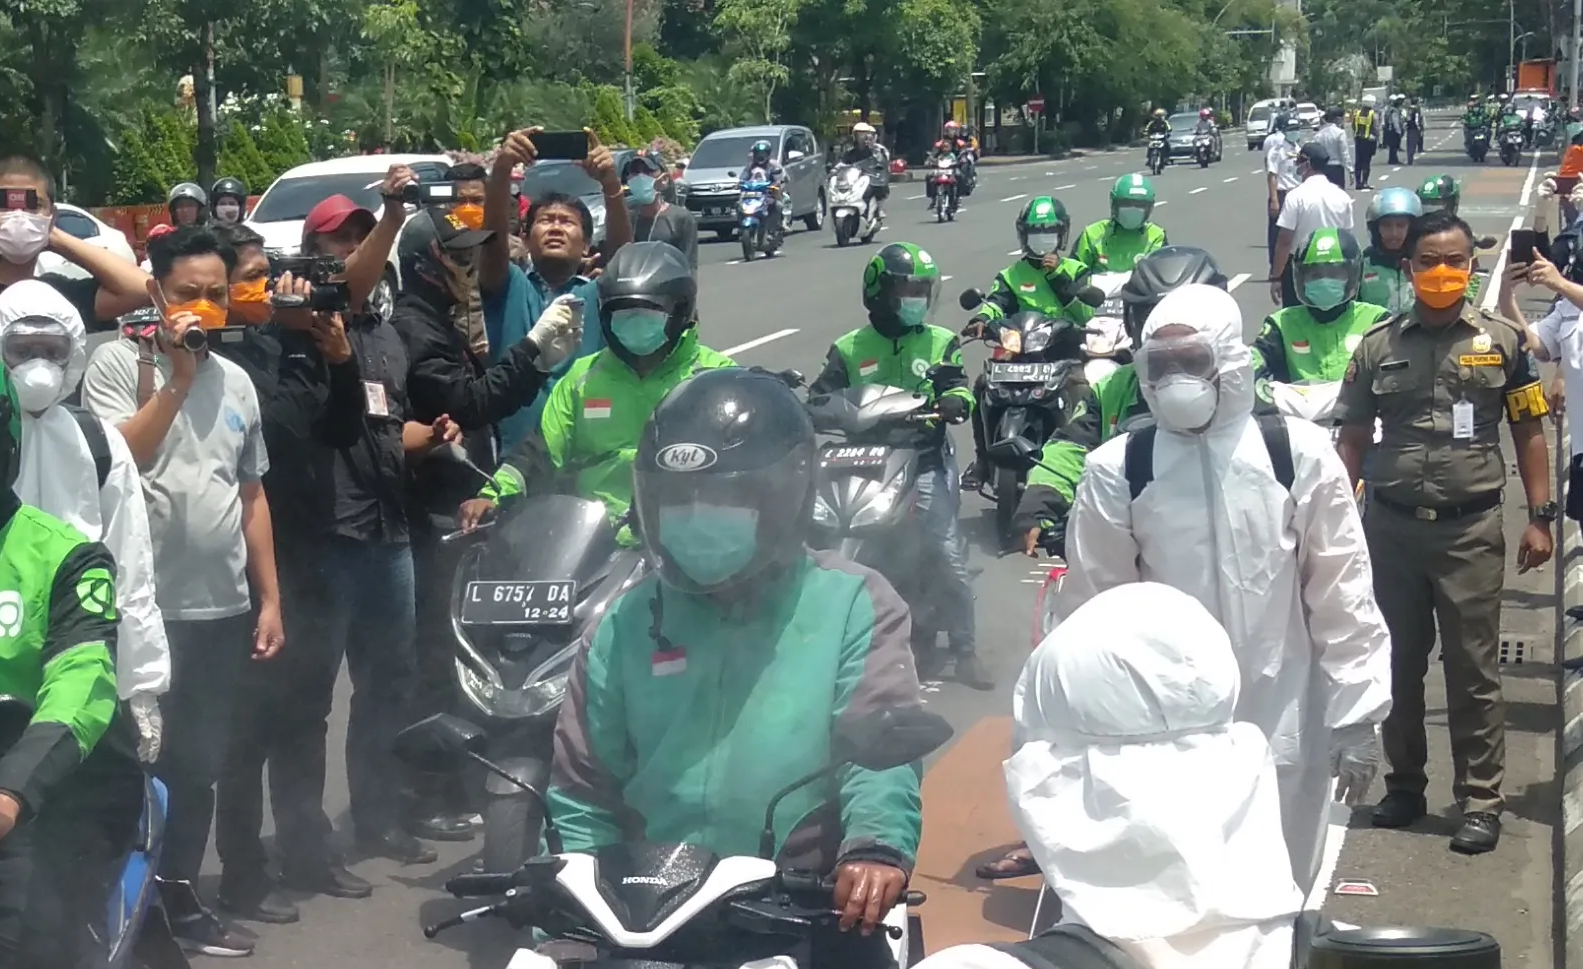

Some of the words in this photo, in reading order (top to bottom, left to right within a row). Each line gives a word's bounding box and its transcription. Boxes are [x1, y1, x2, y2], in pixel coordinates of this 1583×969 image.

[472, 586, 482, 602] L
[493, 585, 535, 602] 6757
[547, 584, 569, 602] DA
[622, 876, 668, 886] HONDA
